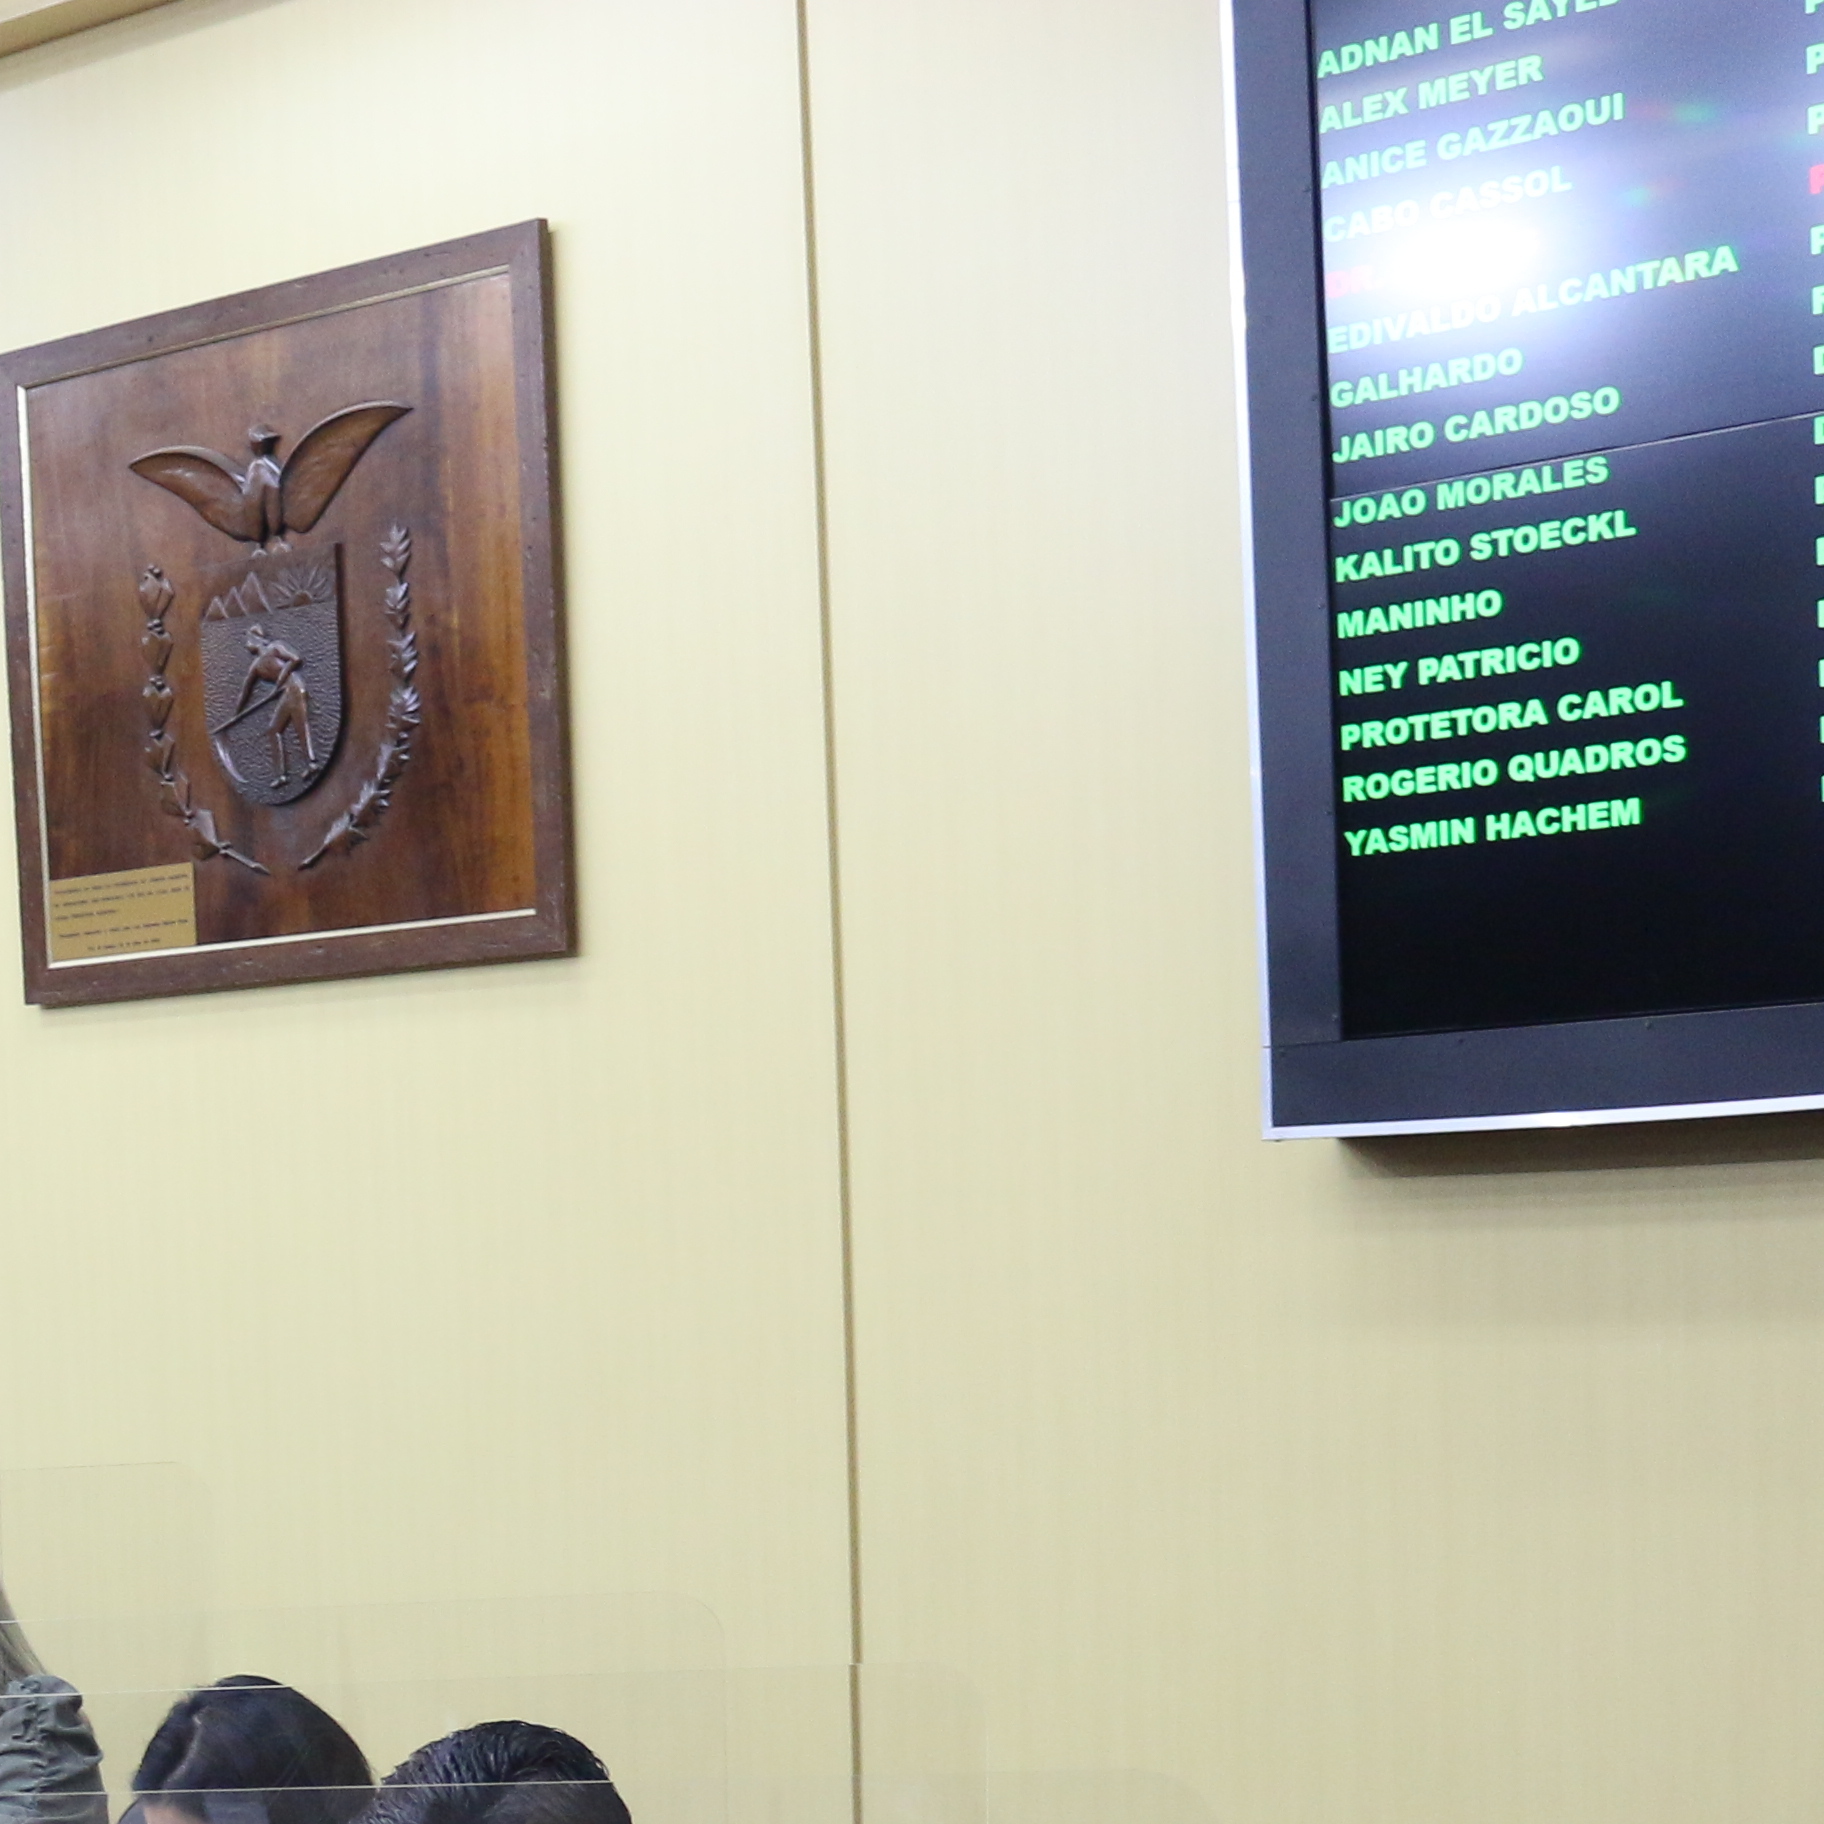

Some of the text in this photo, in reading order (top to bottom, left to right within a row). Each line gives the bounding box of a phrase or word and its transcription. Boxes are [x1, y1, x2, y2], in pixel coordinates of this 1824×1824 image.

[1318, 24, 1438, 77] ADNAN
[1450, 11, 1493, 44] EL
[1320, 55, 1544, 133] ALEX MEYER
[1322, 93, 1624, 188] ANICE GAZZAOUI
[1324, 166, 1572, 242] CABO CASSOL
[1328, 245, 1738, 353] EDIVALDO ALCANTARA
[1330, 348, 1523, 408] GALHARDO
[1332, 387, 1620, 463] JAIRO CARDOSO
[1334, 456, 1609, 528] JOAO MORALES
[1336, 509, 1637, 582] KALITO STOECKL
[1337, 589, 1503, 639] MANINHO
[1339, 637, 1580, 696] NEY PATRICIO
[1341, 681, 1684, 750] PROTETORA CAROL
[1343, 735, 1687, 802] ROGERIO QUADROS
[1345, 798, 1641, 856] YASMIN HACHEM
